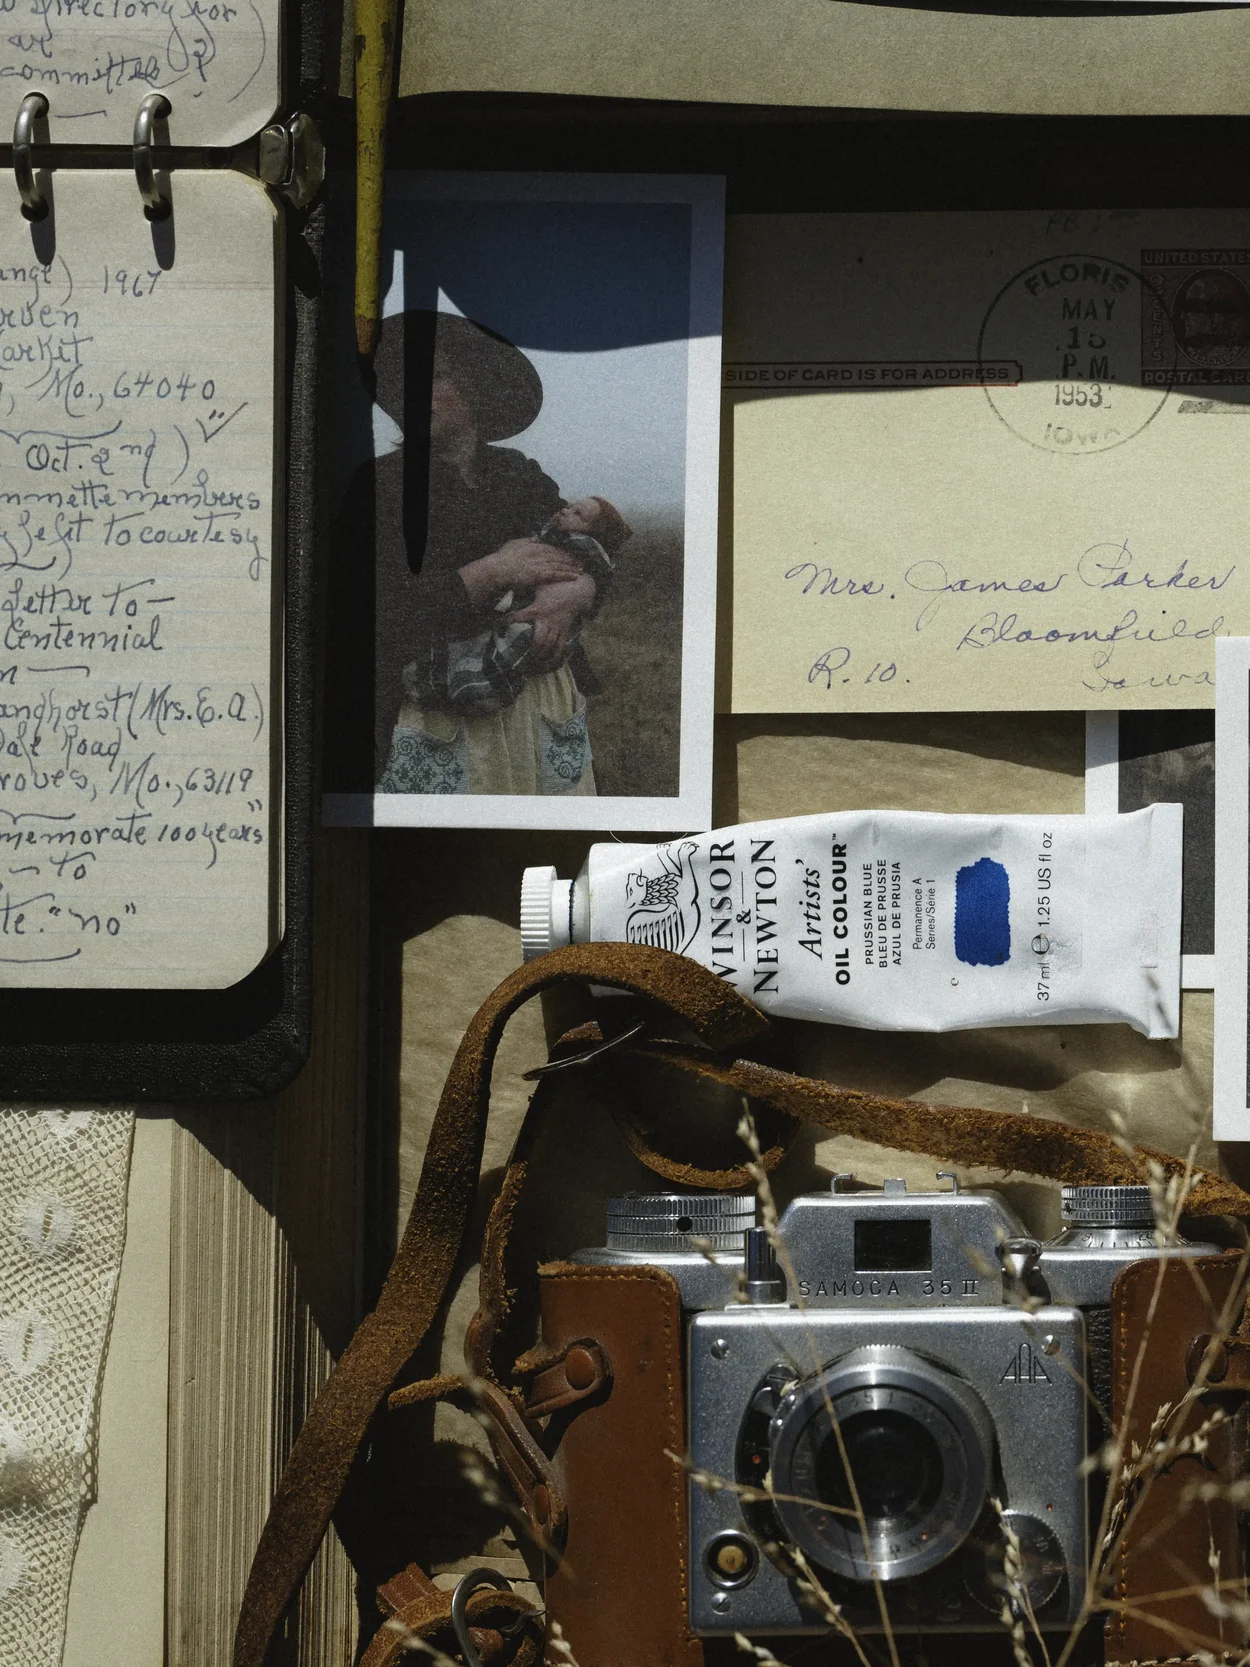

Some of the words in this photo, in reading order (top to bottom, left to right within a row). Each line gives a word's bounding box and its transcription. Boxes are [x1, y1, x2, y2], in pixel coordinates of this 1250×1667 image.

[1144, 251, 1198, 264] UNITED
[101, 265, 163, 298] 1967
[1023, 262, 1130, 296] FLORIS
[1061, 297, 1116, 321] MAY
[114, 370, 215, 401] 64040
[725, 369, 769, 382] SIDE
[773, 369, 798, 381] OF
[802, 369, 853, 381] CARD
[858, 369, 876, 381] IS
[881, 368, 917, 381] FOR
[923, 367, 1009, 380] ADDRESS
[1144, 371, 1208, 384] POSTAL
[1053, 383, 1103, 409] 1953
[784, 562, 897, 600] Mrs.
[904, 559, 1069, 633] James
[806, 646, 849, 690] R.
[185, 767, 253, 795] 63119
[157, 823, 197, 843] 100
[1042, 832, 1053, 849] oz
[862, 862, 873, 897] BLUE
[876, 858, 888, 911] PRUSSE
[890, 861, 902, 909] PRUSIA
[911, 877, 922, 886] A
[1038, 867, 1051, 890] US
[736, 908, 752, 925] &
[749, 838, 779, 995] NEWTON
[877, 915, 888, 932] DE
[891, 912, 902, 930] DE
[912, 889, 923, 950] Permanence
[1037, 896, 1051, 928] 1.25
[863, 901, 875, 965] PRUSSIAN
[877, 936, 888, 969] BLEU
[891, 933, 902, 966] AZUL
[834, 947, 851, 986] OIL
[1037, 982, 1051, 1001] 37
[799, 1279, 901, 1297] SAMOCA
[922, 1279, 953, 1297] 35
